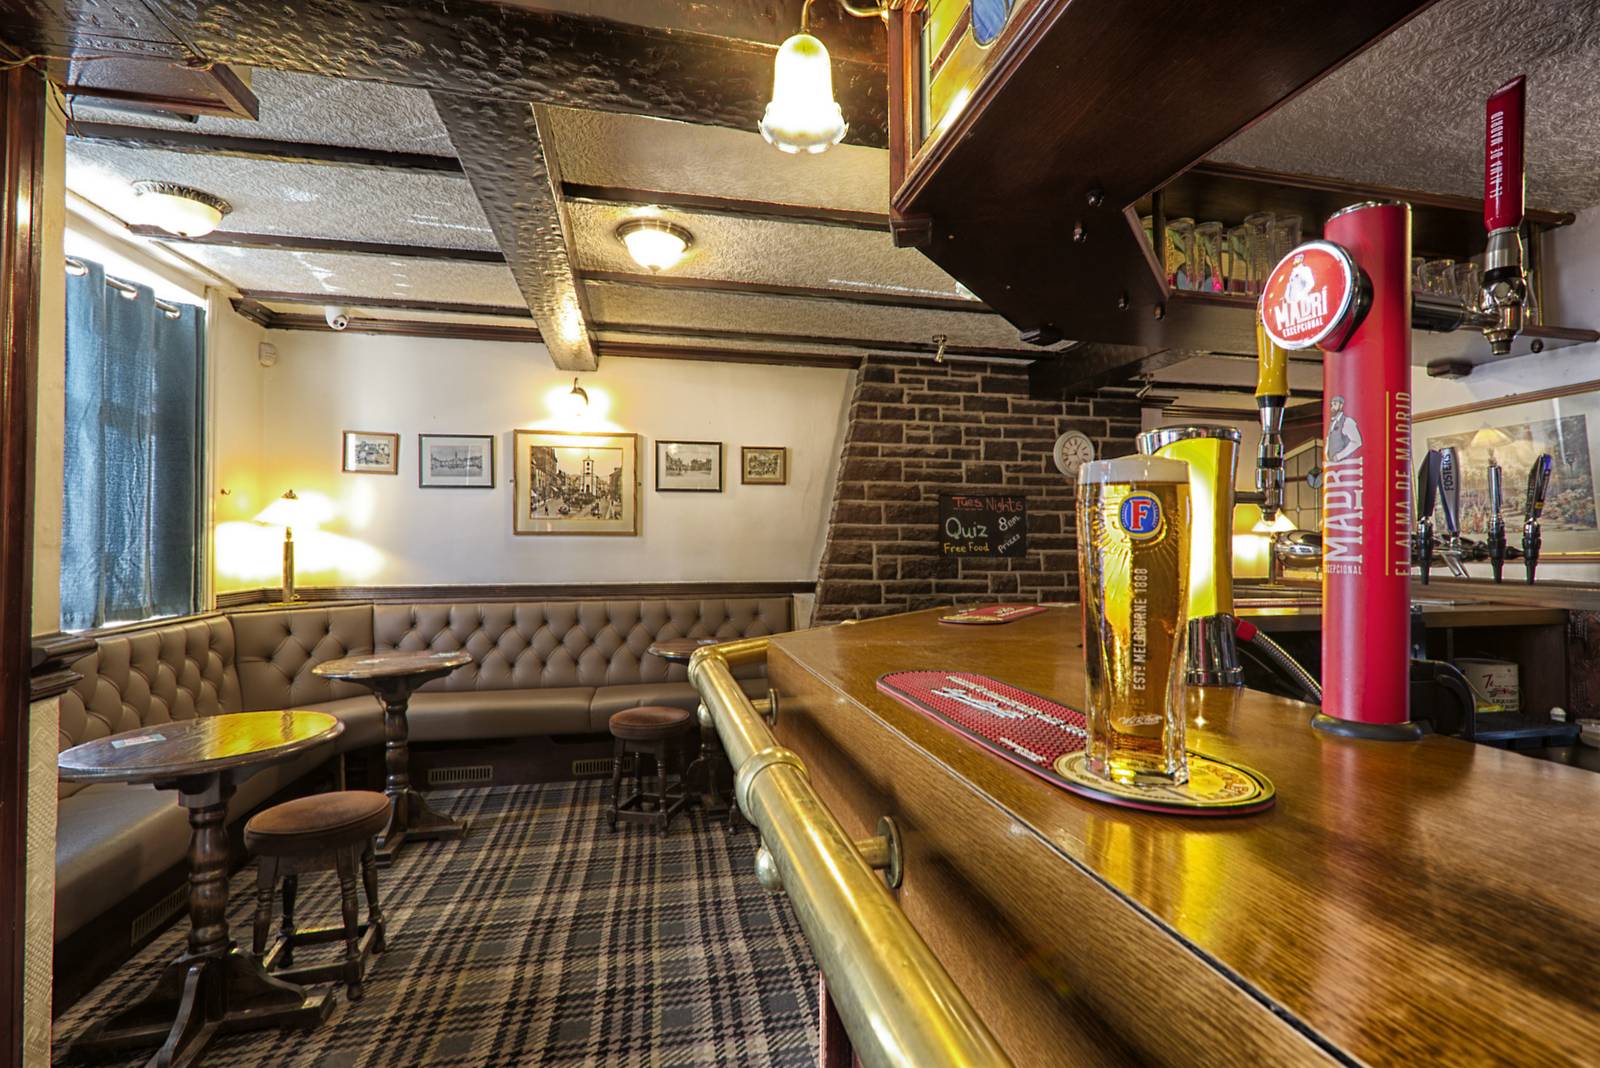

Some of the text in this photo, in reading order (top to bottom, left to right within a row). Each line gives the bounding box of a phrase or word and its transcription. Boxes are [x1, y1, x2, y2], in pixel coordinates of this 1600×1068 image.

[1490, 111, 1504, 146] MADRID
[1490, 146, 1504, 160] DE
[1489, 160, 1503, 185] ALMA
[1395, 391, 1411, 576] EL ALMA DE MADRID
[952, 496, 1024, 513] Tues Nights
[1129, 499, 1152, 531] F
[945, 517, 989, 540] Quiz
[943, 541, 990, 554] Free Food
[1134, 568, 1148, 593] 1888
[1133, 598, 1147, 663] MELBOURNE
